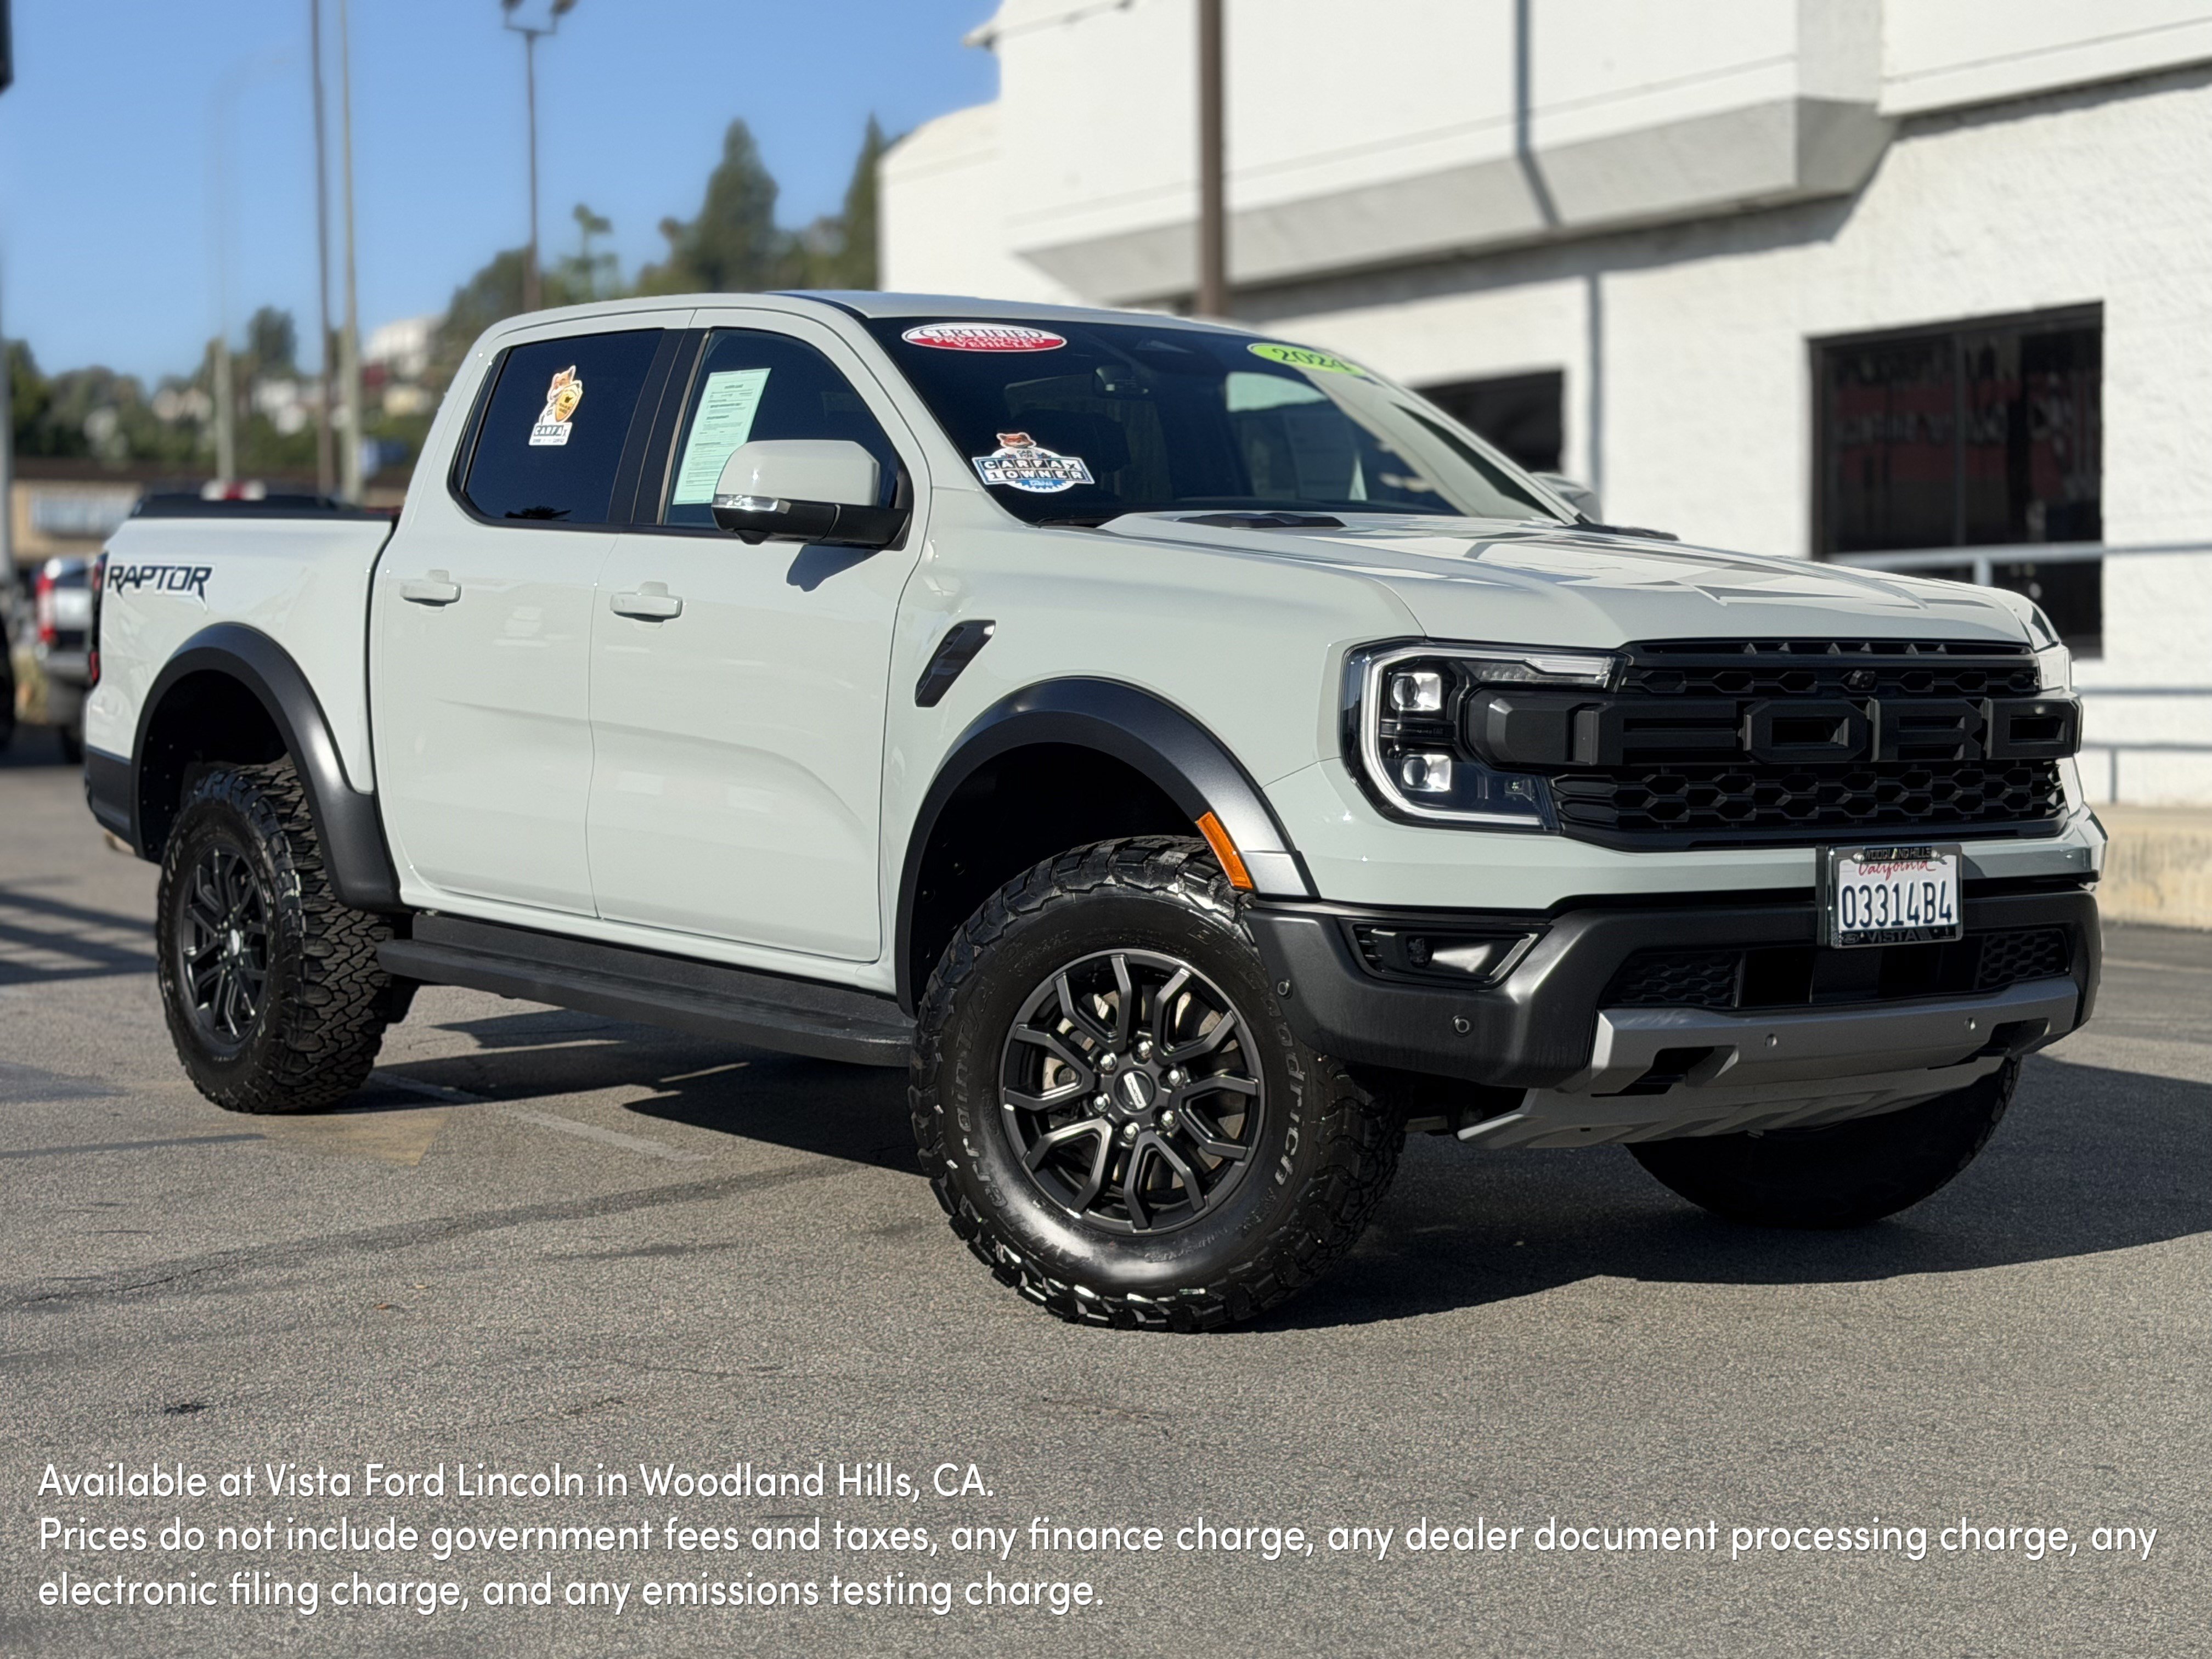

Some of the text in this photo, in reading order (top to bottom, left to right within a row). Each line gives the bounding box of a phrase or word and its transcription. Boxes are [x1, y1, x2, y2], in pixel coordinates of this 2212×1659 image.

[1271, 347, 1352, 371] 2024
[983, 459, 1080, 470] CARFAX
[1006, 470, 1084, 479] OWNER
[108, 566, 213, 604] RAPTOR
[1858, 859, 1937, 881] California
[1841, 881, 1953, 928] 03314B4
[1867, 928, 1918, 944] VISTA
